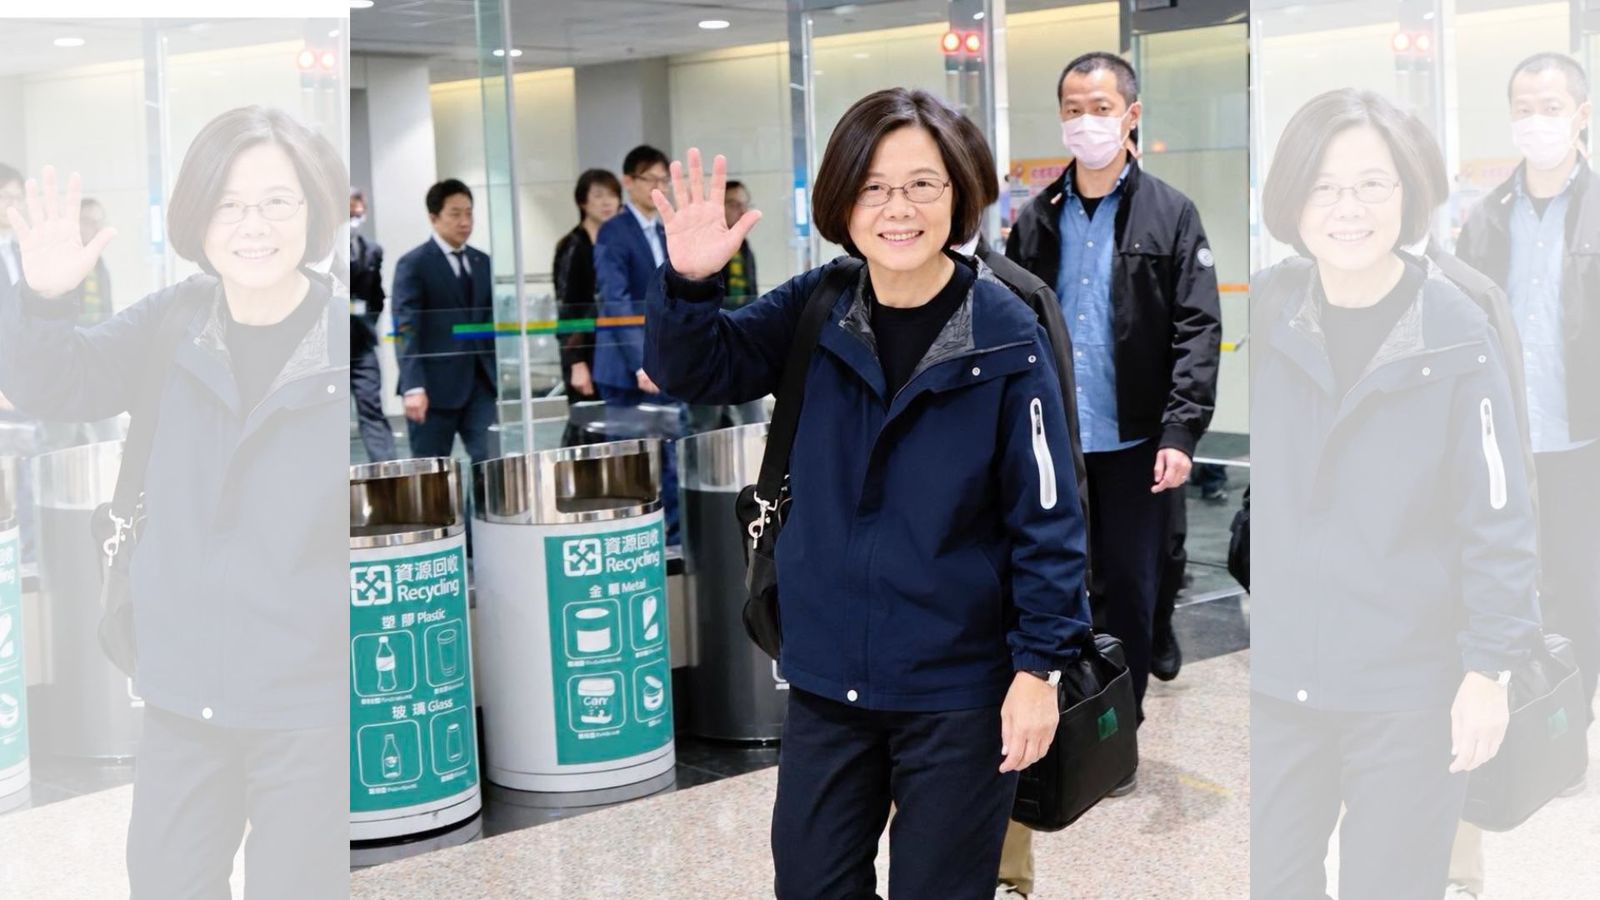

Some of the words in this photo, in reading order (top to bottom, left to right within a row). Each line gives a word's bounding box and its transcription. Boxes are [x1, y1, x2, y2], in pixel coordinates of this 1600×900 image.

[604, 528, 658, 556] 資源回收
[395, 554, 458, 584] 資源回收
[606, 551, 660, 573] Recycling
[397, 579, 459, 603] Recycling
[622, 578, 646, 592] Metal
[418, 608, 446, 623] Plastic
[428, 699, 453, 712] Glass
